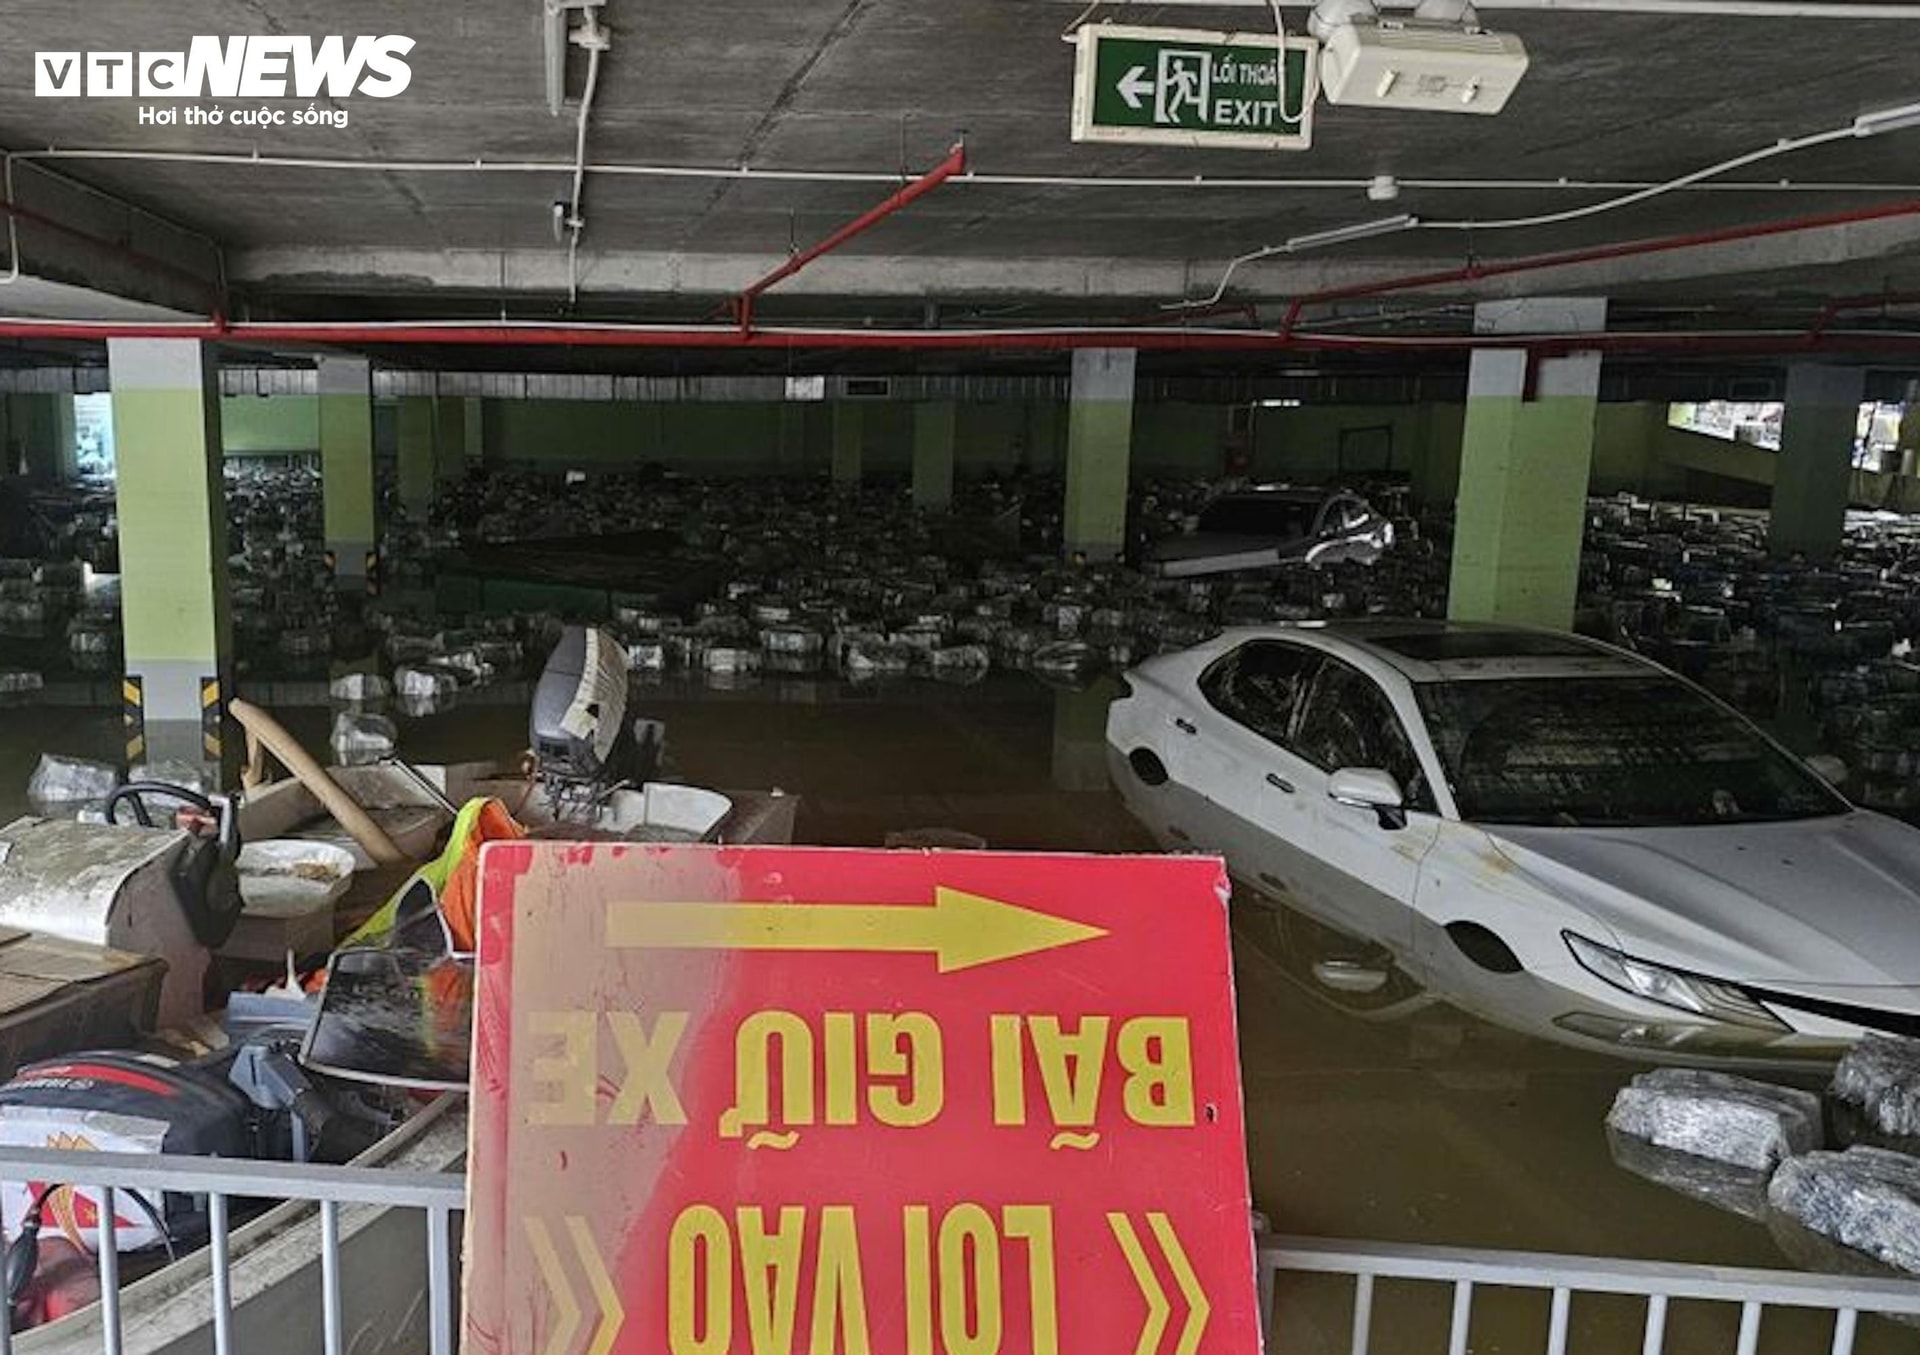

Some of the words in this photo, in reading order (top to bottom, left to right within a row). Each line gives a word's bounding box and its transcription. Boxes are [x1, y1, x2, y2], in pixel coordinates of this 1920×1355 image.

[1214, 98, 1278, 126] EXIT
[523, 1011, 689, 1125] XE
[719, 1010, 944, 1151] GIỮ
[990, 1013, 1197, 1150] BÃI
